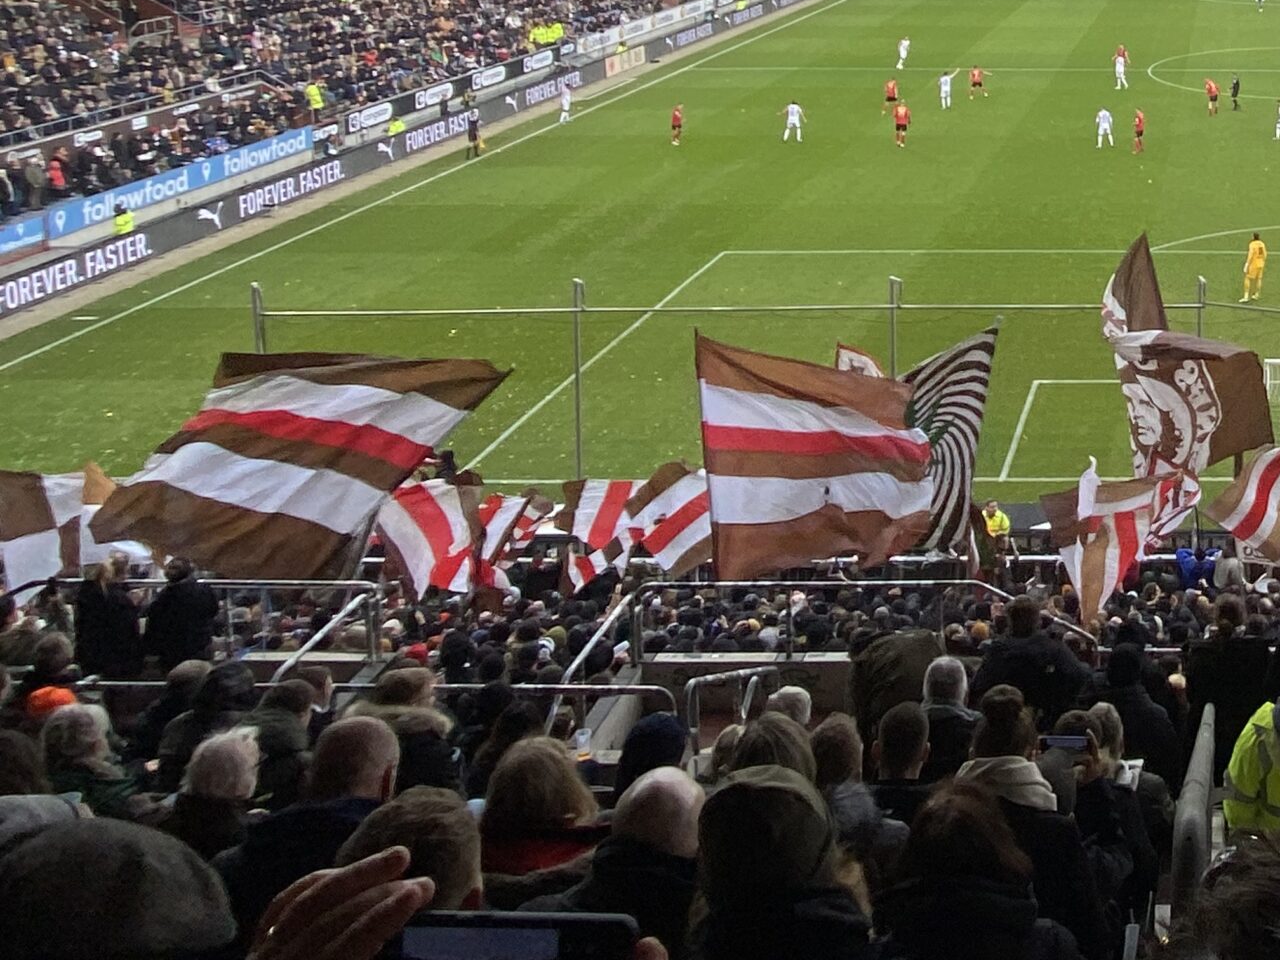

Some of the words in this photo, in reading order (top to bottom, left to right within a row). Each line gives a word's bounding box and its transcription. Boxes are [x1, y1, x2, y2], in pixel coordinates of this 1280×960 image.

[223, 130, 306, 175] followfood
[83, 169, 190, 225] followfood
[239, 170, 300, 218] FOREVER.
[300, 159, 345, 196] FASTER.
[85, 232, 154, 280] FASTER.
